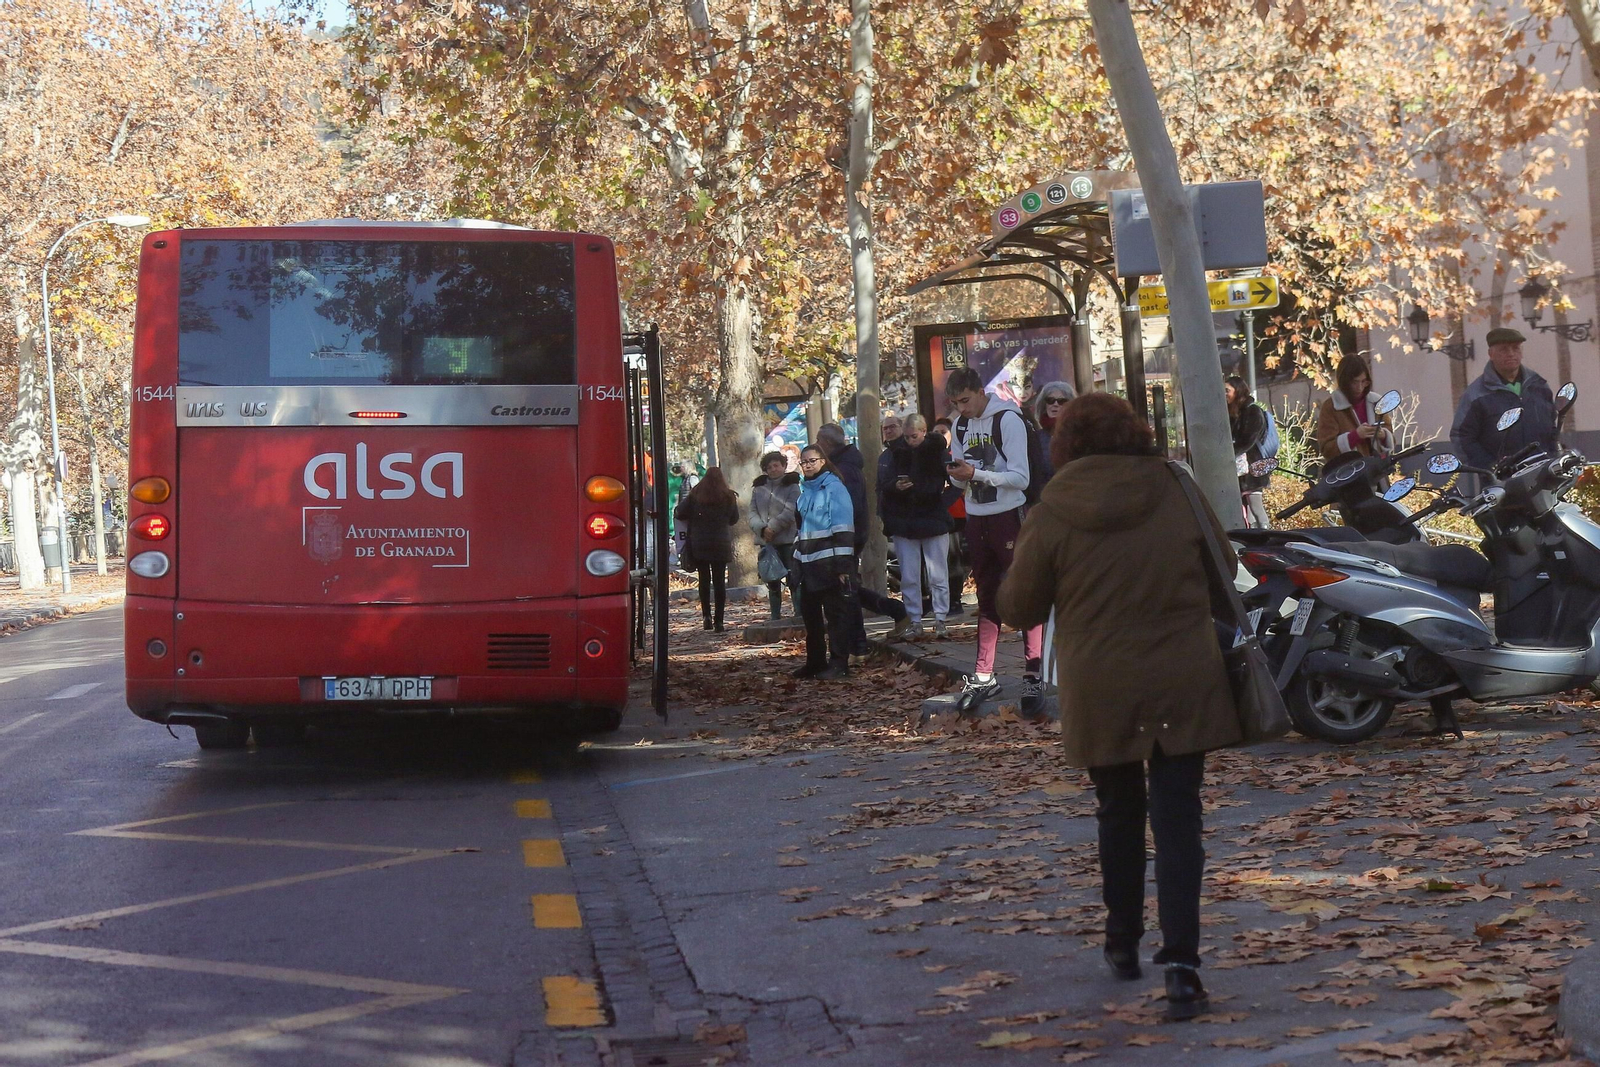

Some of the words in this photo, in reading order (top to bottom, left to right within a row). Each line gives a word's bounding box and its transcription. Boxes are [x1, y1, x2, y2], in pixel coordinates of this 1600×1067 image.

[1002, 213, 1017, 222] 33
[1027, 198, 1035, 207] 9
[1049, 190, 1063, 198] 121
[1075, 184, 1088, 193] 13
[992, 340, 1001, 348] lo
[1004, 340, 1020, 348] vas
[1031, 334, 1069, 347] perder?
[490, 405, 571, 416] Castrosua
[303, 441, 464, 499] alsa
[340, 681, 384, 697] 6341
[392, 680, 427, 697] DPH
